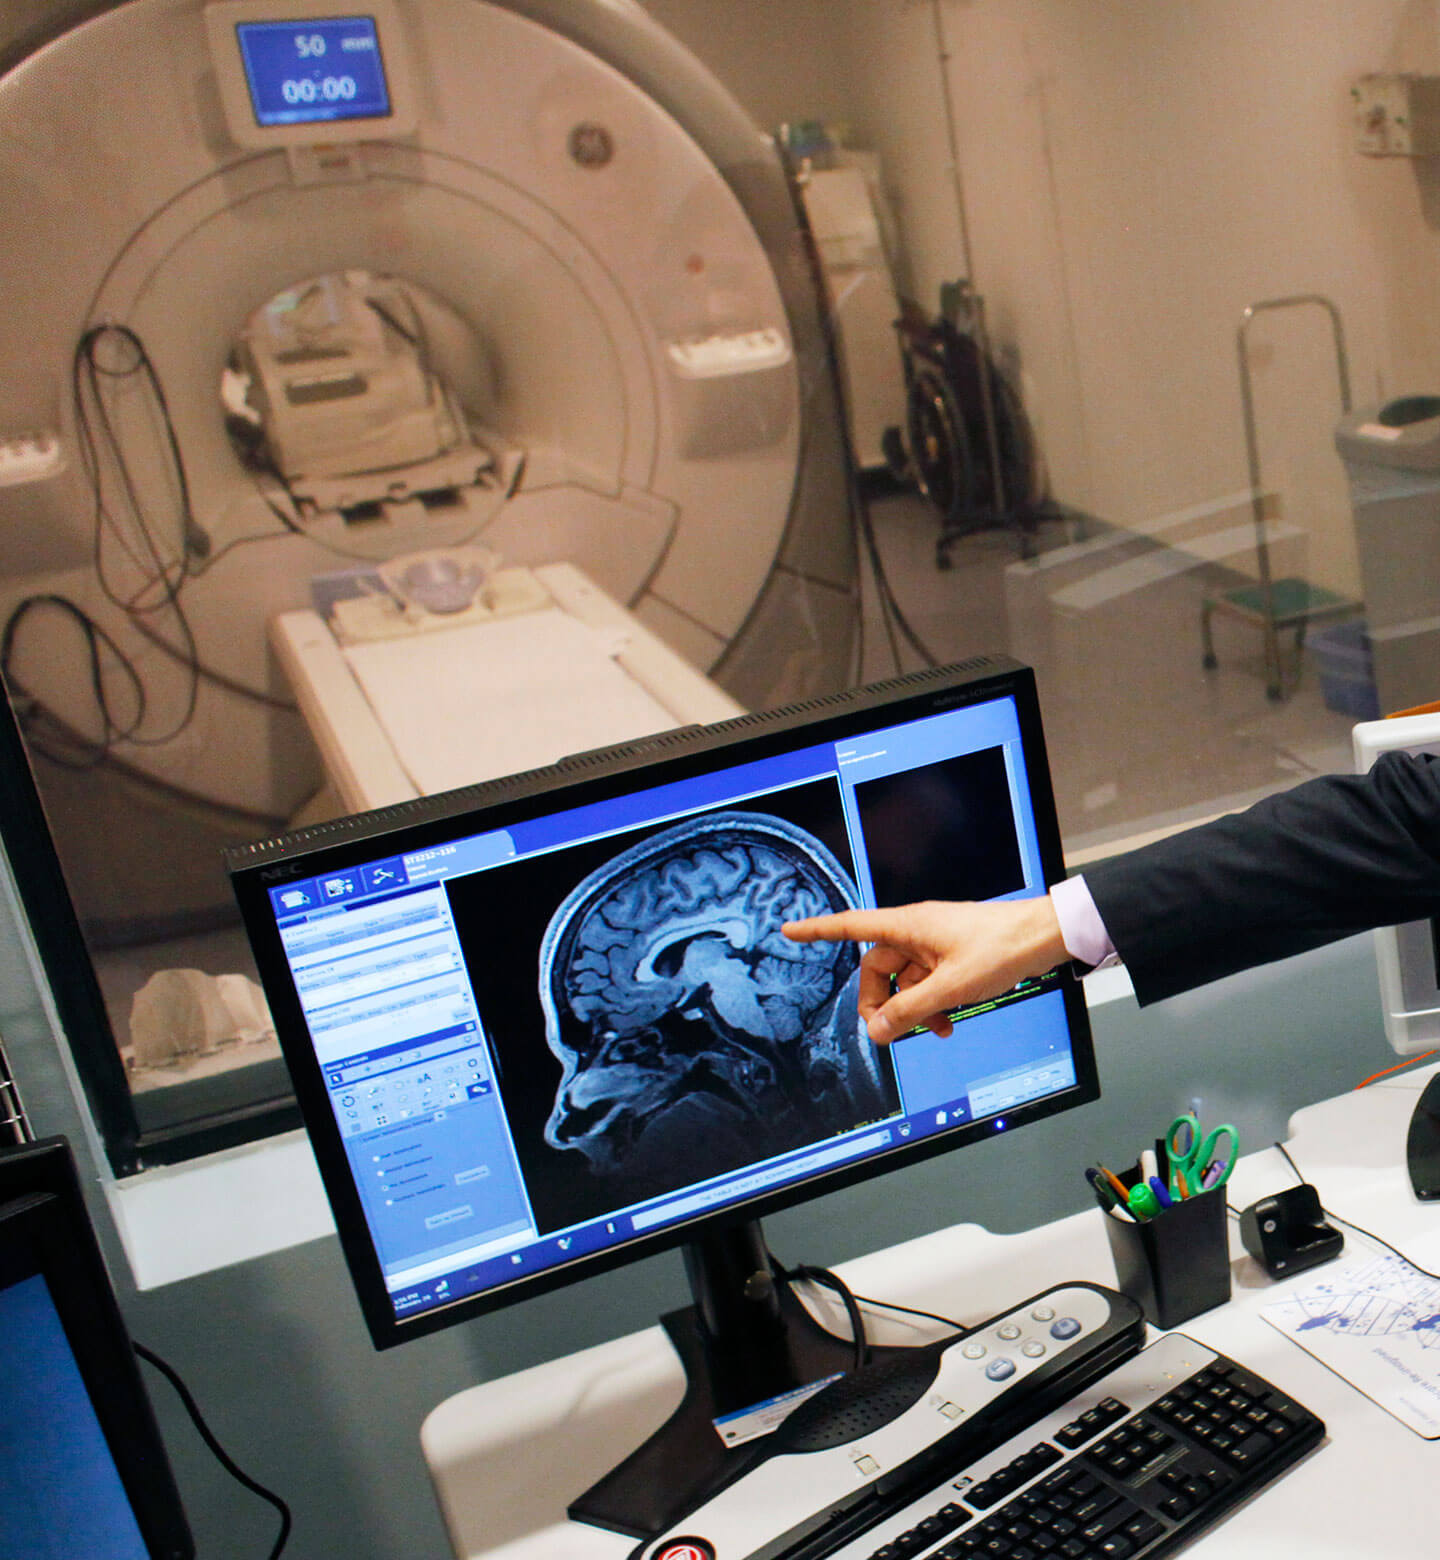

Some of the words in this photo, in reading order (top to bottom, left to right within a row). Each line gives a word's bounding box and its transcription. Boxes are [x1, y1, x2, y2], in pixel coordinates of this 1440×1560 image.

[294, 34, 326, 58] 50
[282, 75, 356, 104] 00:00
[260, 861, 304, 881] NEC
